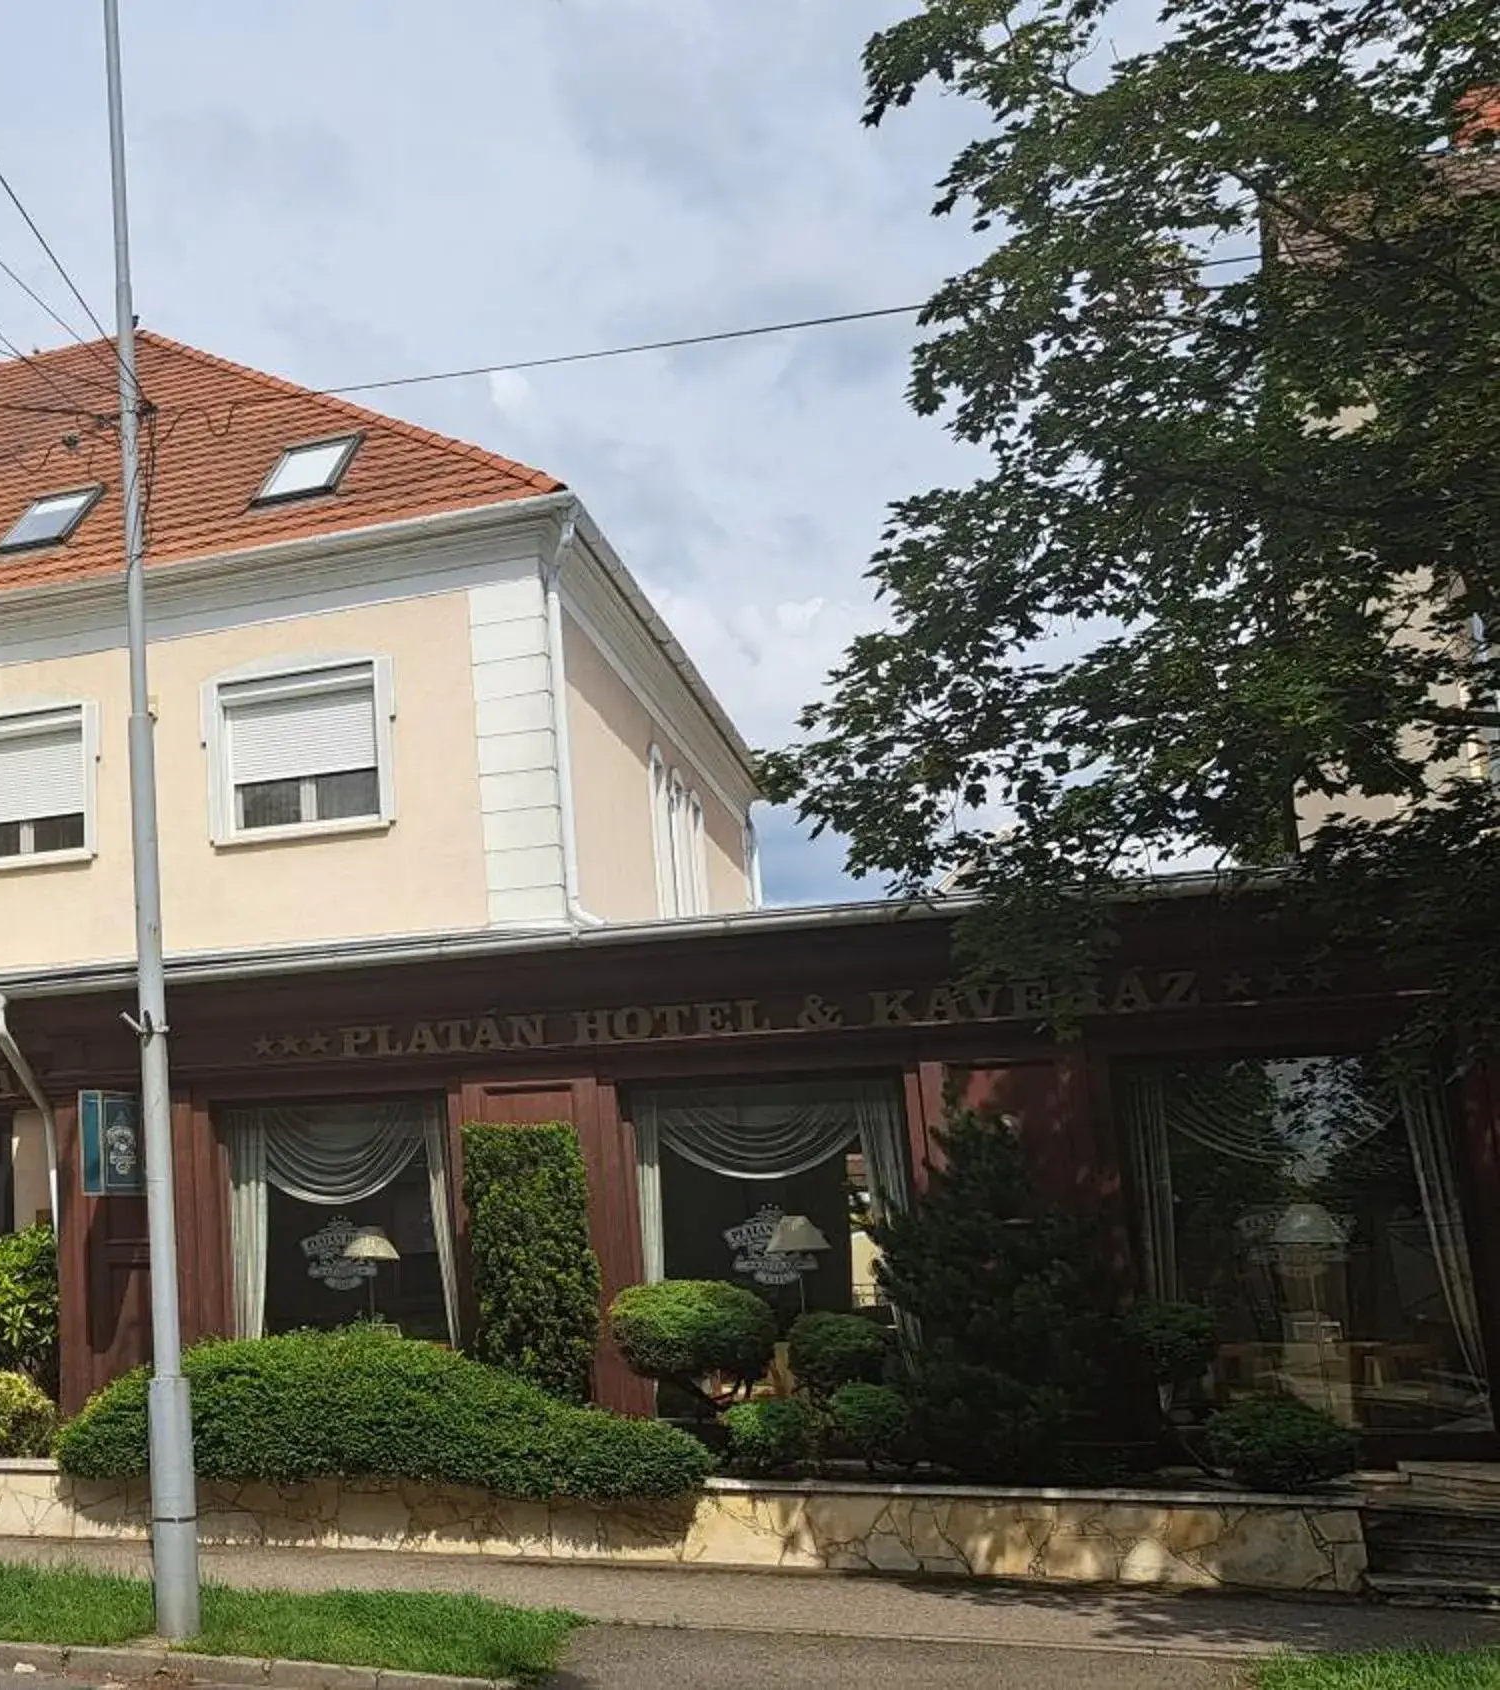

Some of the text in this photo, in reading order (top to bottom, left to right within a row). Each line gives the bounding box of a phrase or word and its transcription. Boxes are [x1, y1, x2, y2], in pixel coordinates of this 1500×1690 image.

[341, 1007, 547, 1057] PLATÁN
[571, 999, 770, 1046] HOTEL
[797, 993, 843, 1031] &
